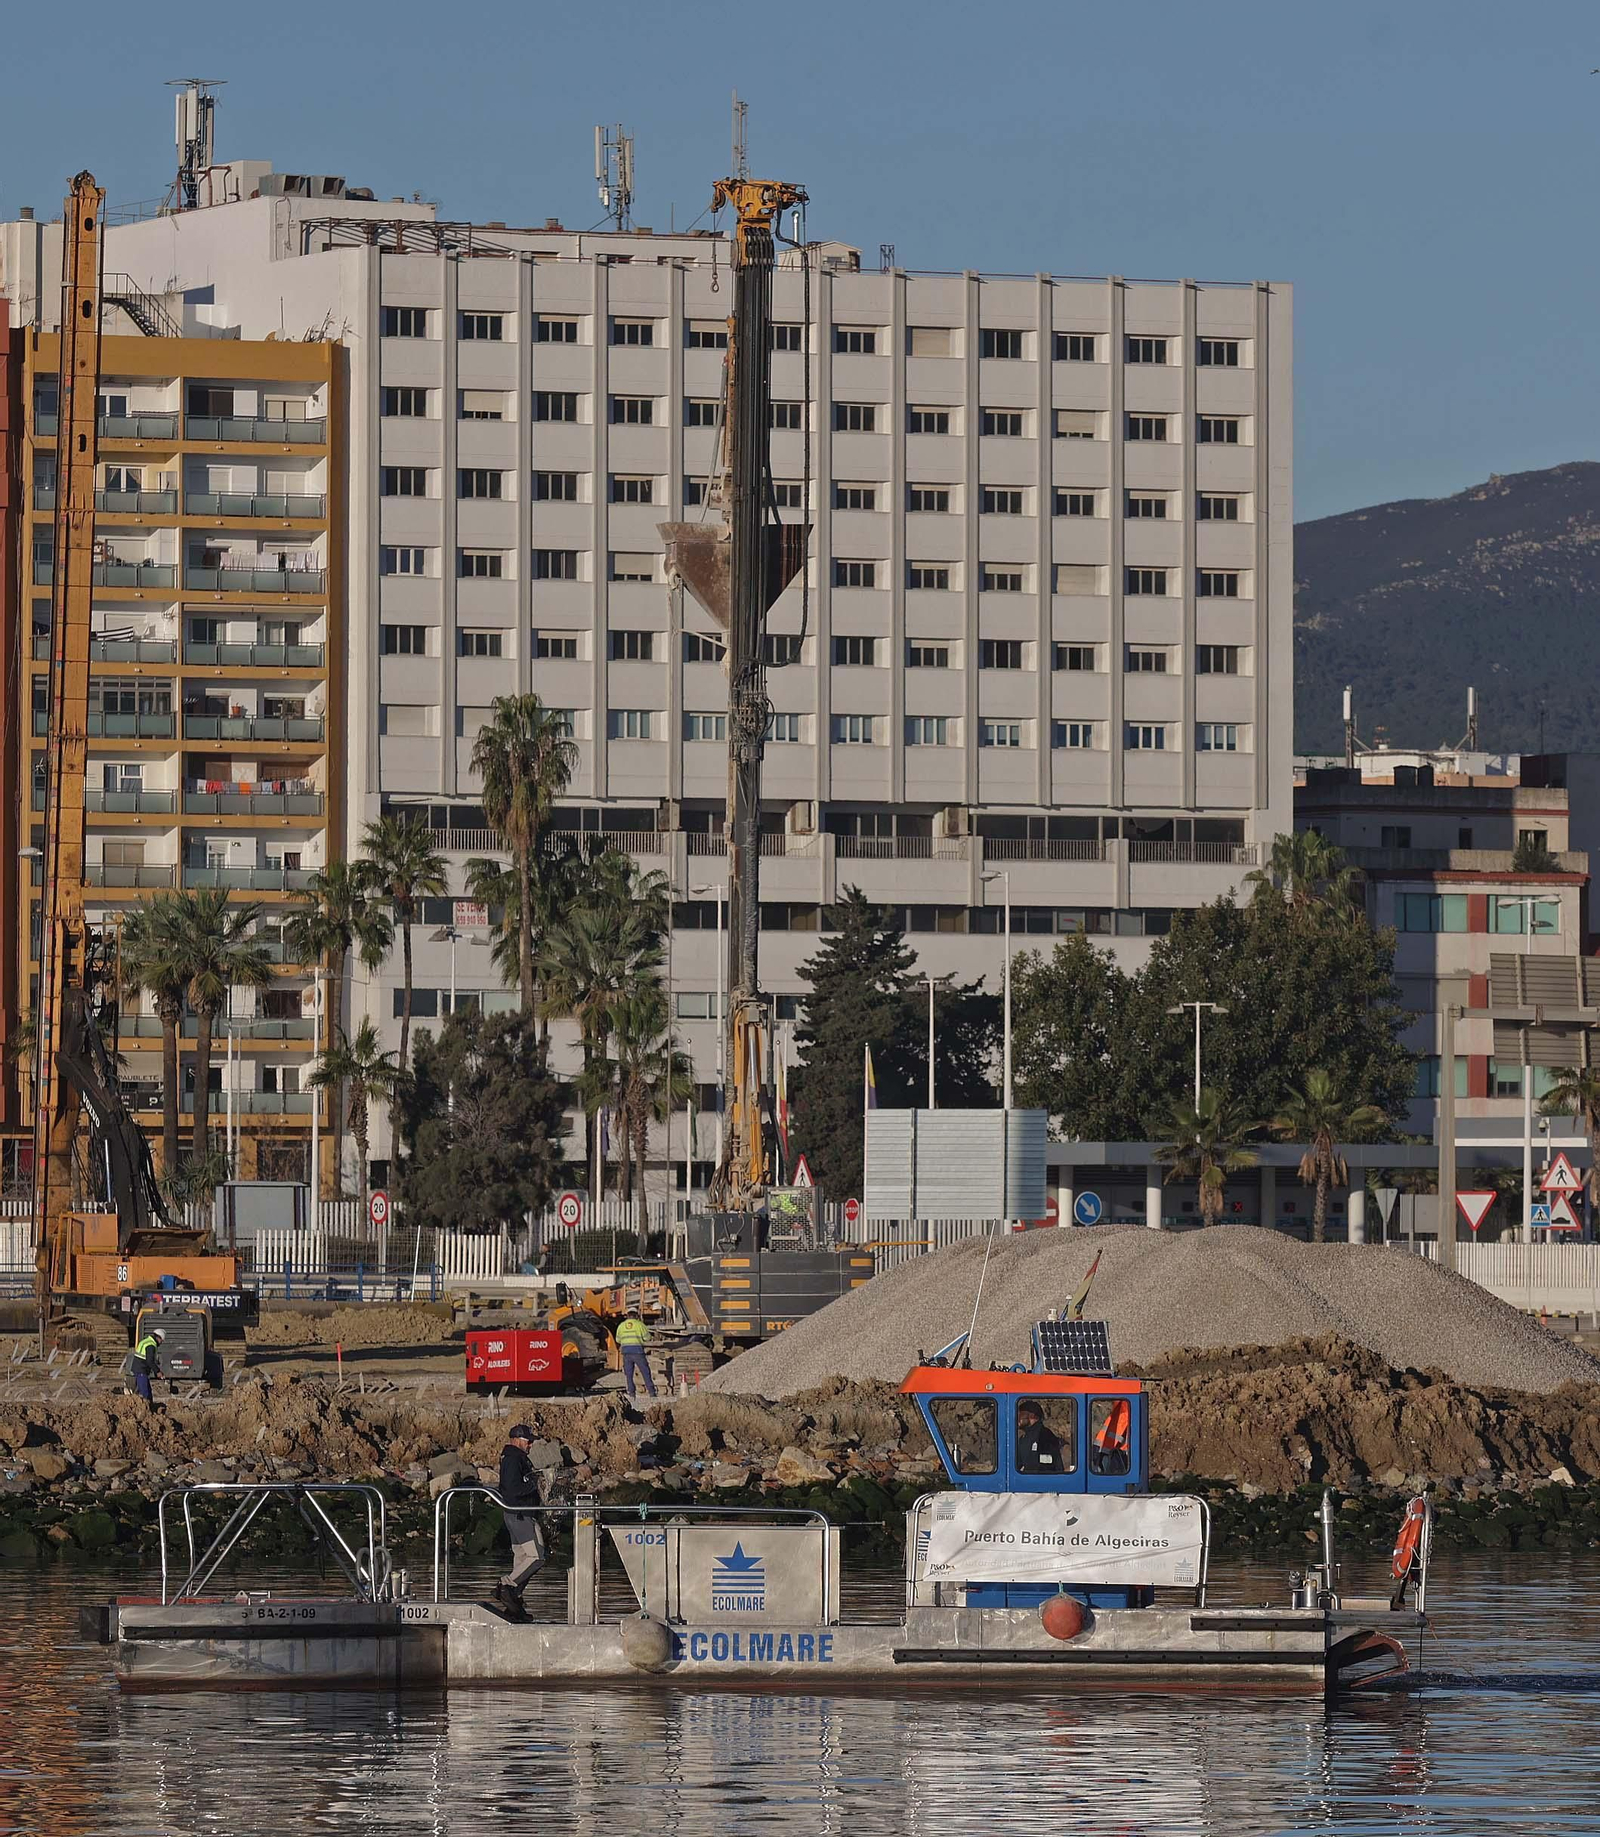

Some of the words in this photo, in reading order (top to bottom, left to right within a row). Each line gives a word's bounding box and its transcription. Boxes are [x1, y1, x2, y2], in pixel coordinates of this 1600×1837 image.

[82, 1089, 101, 1128] VOLVO
[373, 1202, 385, 1214] 20
[563, 1204, 576, 1216] 20
[117, 1265, 128, 1282] 86
[163, 1295, 241, 1307] TERRATEST
[488, 1341, 504, 1354] RINO
[529, 1341, 549, 1349] RINO
[625, 1533, 667, 1545] 1002
[965, 1530, 1016, 1544] Puerto
[1021, 1531, 1065, 1546] Bahía
[1070, 1534, 1090, 1546] de
[1094, 1534, 1169, 1550] Algeciras
[712, 1596, 765, 1611] ECOLMARE
[257, 1608, 316, 1619] BA-2-1-09
[400, 1607, 429, 1619] 1002
[672, 1632, 834, 1662] ECOLMARE
